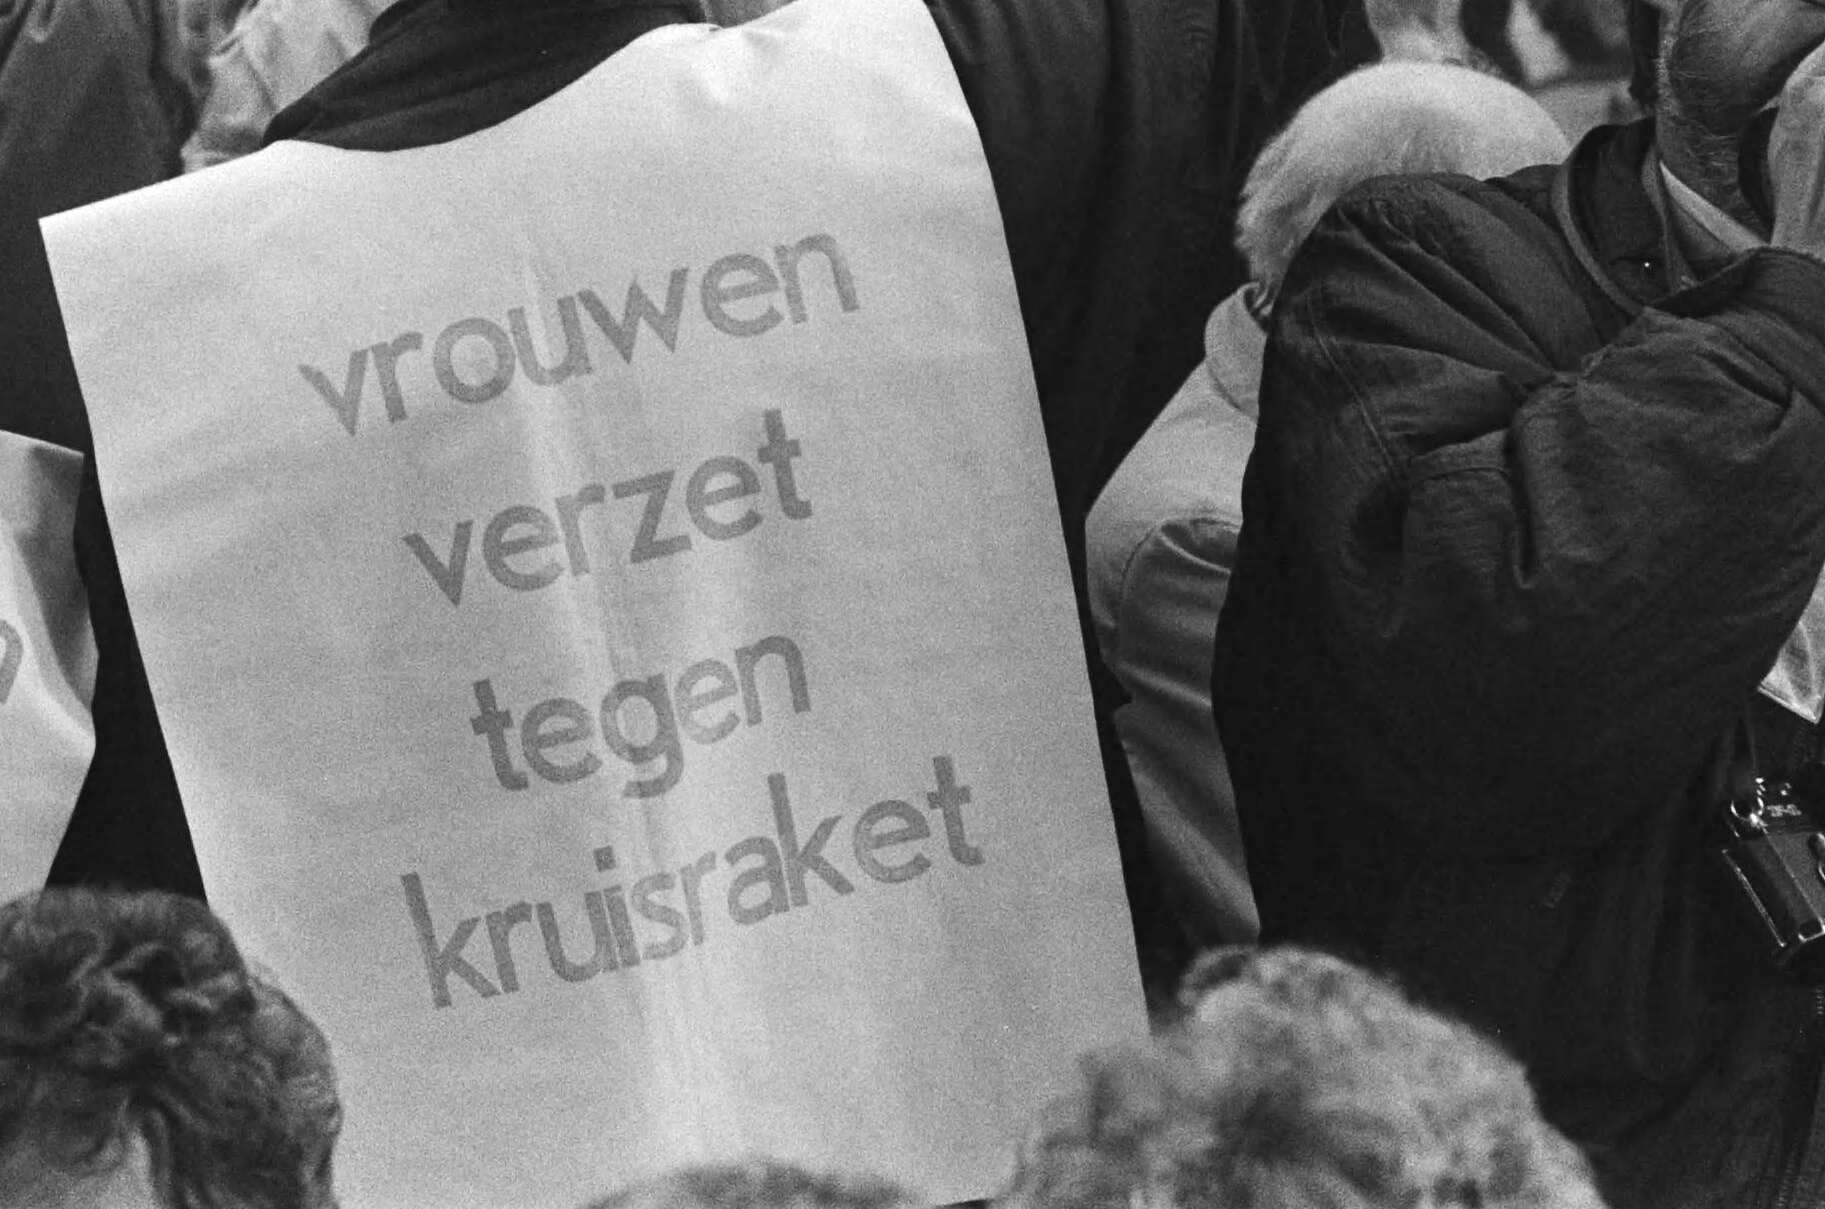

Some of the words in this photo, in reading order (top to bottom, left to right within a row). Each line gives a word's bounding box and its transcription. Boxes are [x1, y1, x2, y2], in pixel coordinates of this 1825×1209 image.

[298, 231, 860, 437] vrouwen
[402, 408, 813, 607] verzet
[470, 630, 812, 800] tegen
[400, 756, 984, 1010] kruisraket
